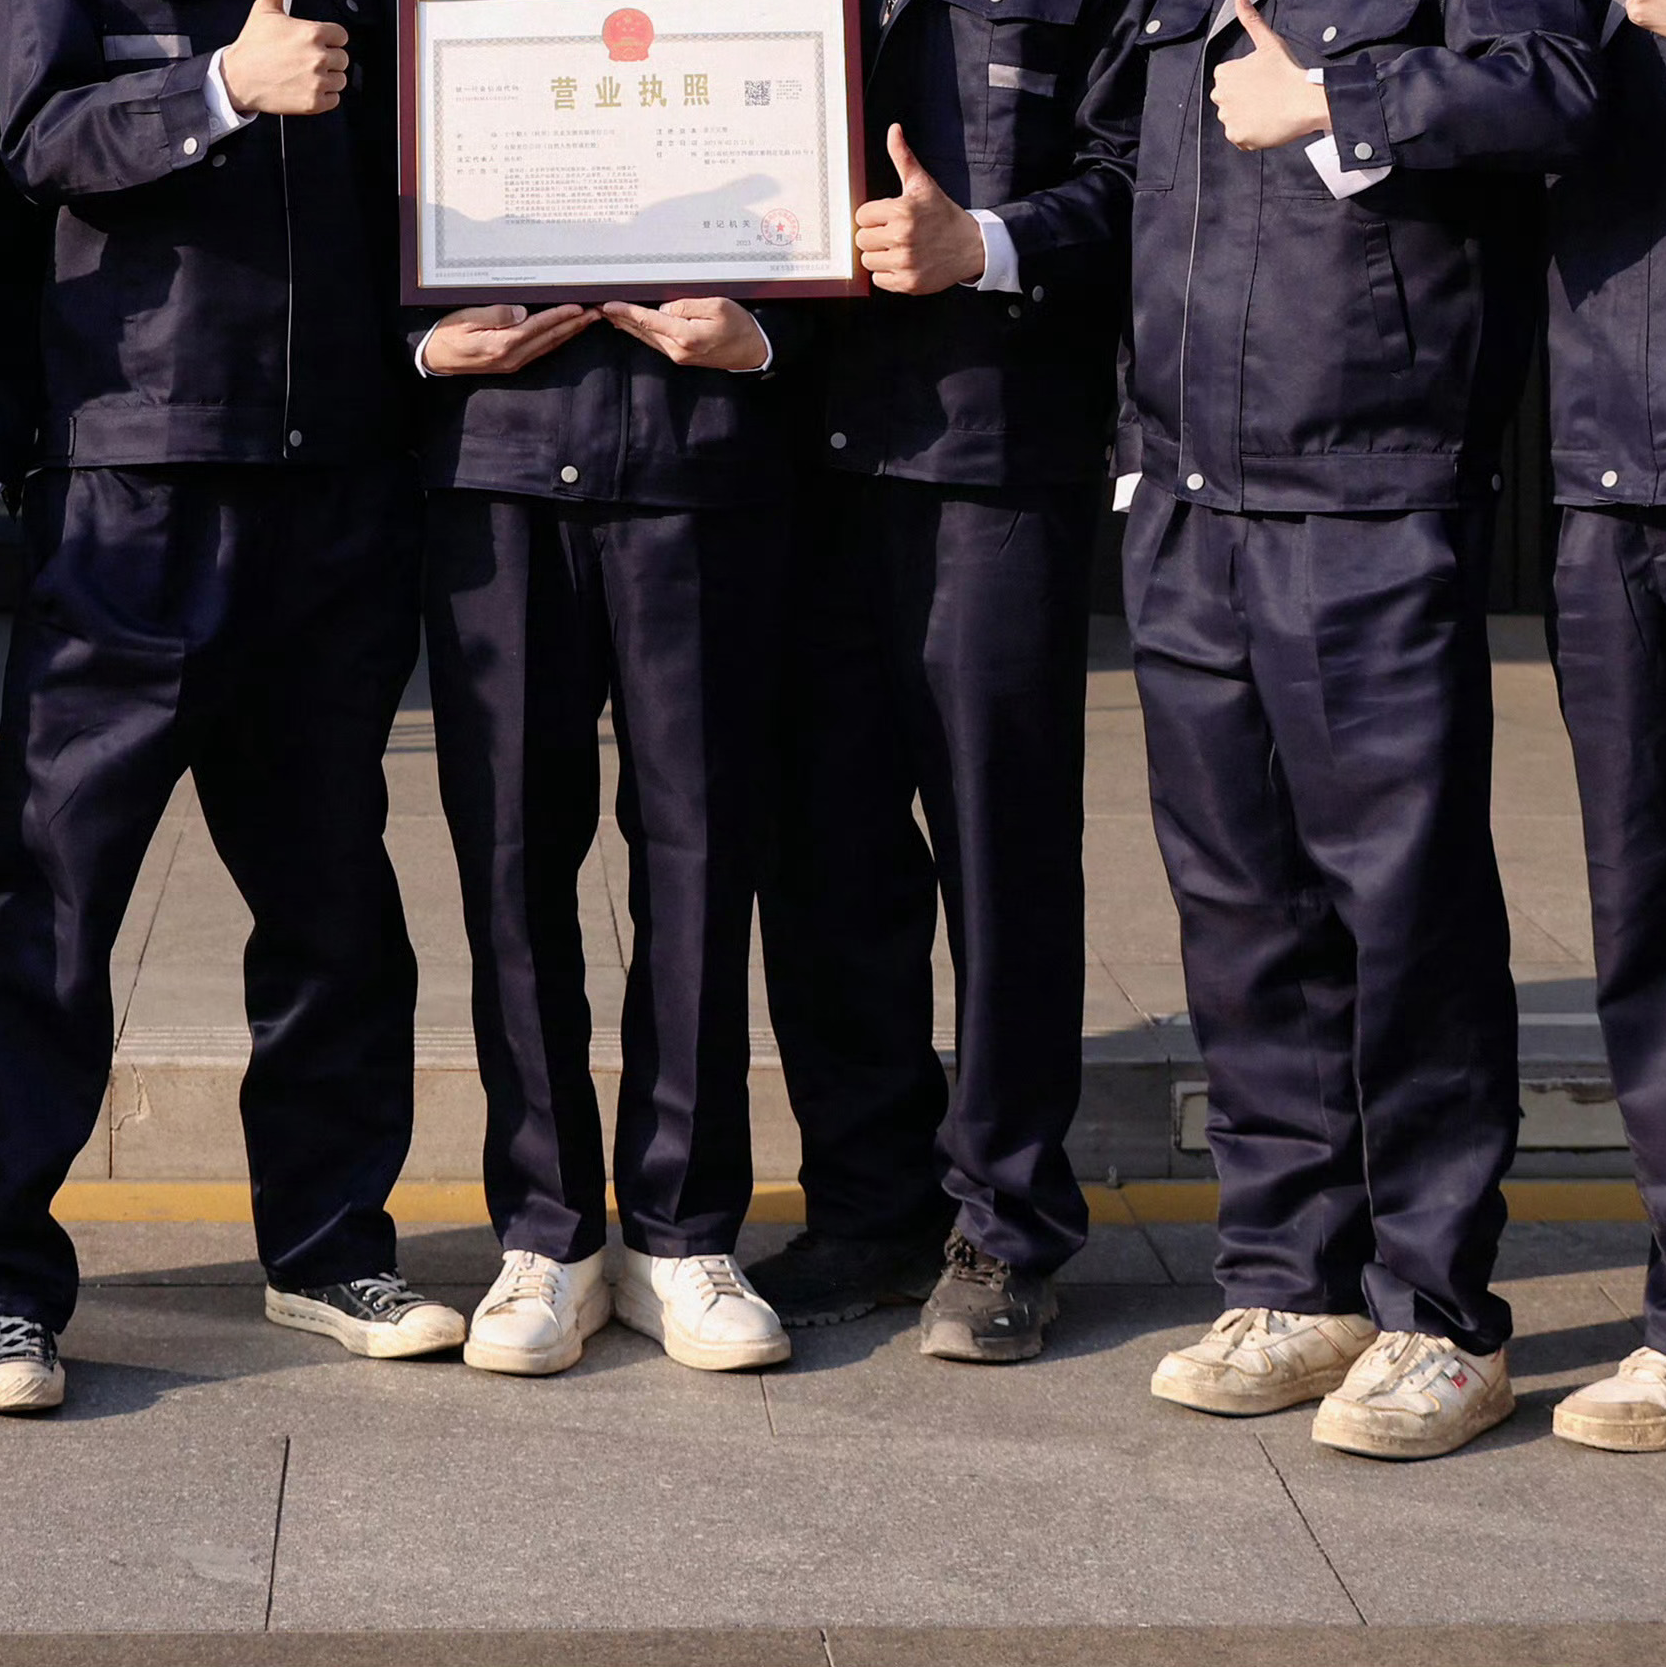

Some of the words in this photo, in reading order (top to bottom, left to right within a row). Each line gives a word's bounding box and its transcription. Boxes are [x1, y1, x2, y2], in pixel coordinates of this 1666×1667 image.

[551, 73, 710, 110] 营业执照
[703, 219, 751, 229] 登记机关
